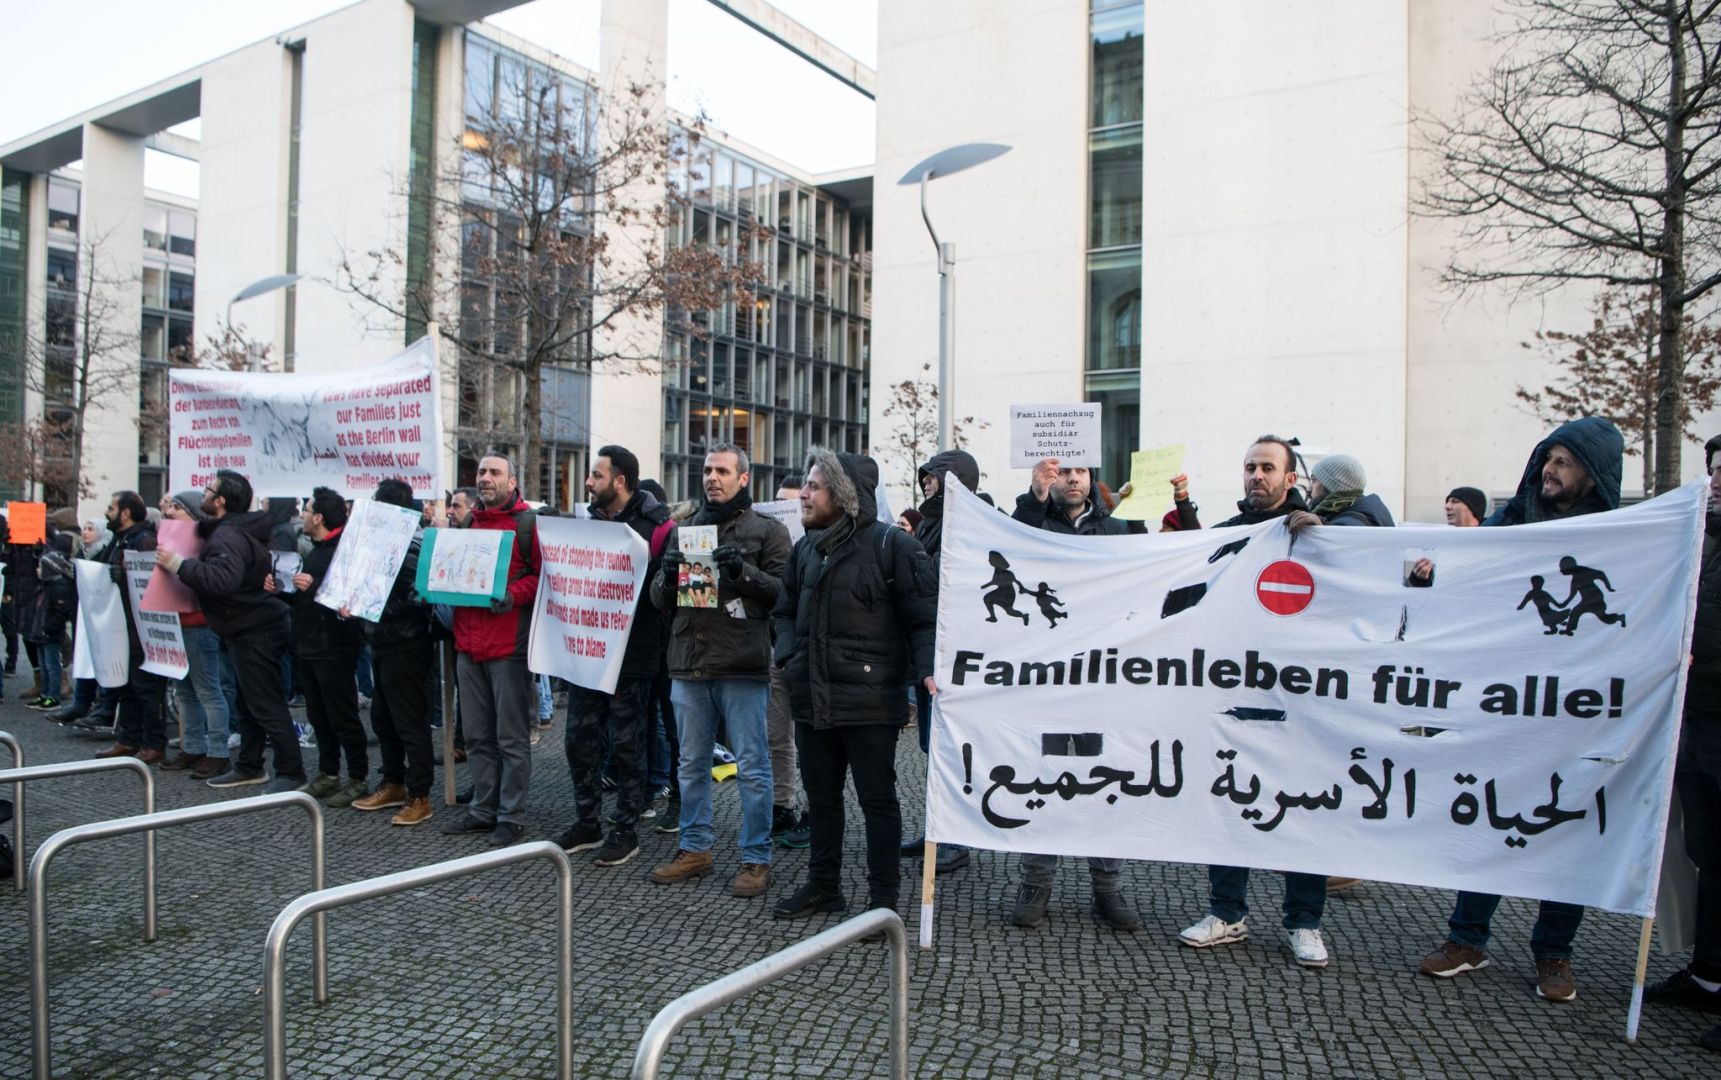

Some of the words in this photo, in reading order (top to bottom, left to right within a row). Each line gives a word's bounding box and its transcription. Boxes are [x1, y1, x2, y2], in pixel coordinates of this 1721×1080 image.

[175, 400, 191, 412] der
[336, 409, 352, 424] our
[354, 403, 396, 422] Families
[399, 400, 422, 422] just
[1016, 410, 1095, 419] Familiennachzug
[191, 419, 208, 430] zum
[1032, 430, 1079, 438] subsidiär
[1034, 420, 1056, 428] auch
[336, 433, 347, 446] as
[347, 429, 364, 446] the
[365, 427, 396, 445] Berlin
[398, 424, 422, 442] wall
[1037, 440, 1074, 448] Schutz-
[213, 453, 229, 468] eine
[230, 455, 246, 467] neue
[344, 452, 362, 468] has
[361, 449, 395, 467] divided
[396, 452, 420, 469] your
[1023, 449, 1086, 459] berechtigte!
[411, 473, 432, 490] past
[560, 544, 569, 564] of
[568, 545, 594, 571] stopping
[595, 547, 606, 569] the
[606, 550, 635, 576] reunion,
[568, 577, 582, 596] arms
[583, 576, 596, 598] that
[597, 579, 635, 605] destroyed
[569, 604, 580, 626] and
[580, 606, 599, 628] made
[600, 610, 609, 629] us
[576, 635, 585, 656] to
[585, 636, 607, 660] blame
[951, 648, 1349, 700] Familienleben
[1371, 664, 1463, 709] für
[1479, 675, 1625, 719] alle!
[1210, 747, 1417, 833] الأسرية
[1450, 772, 1607, 849] الحياة
